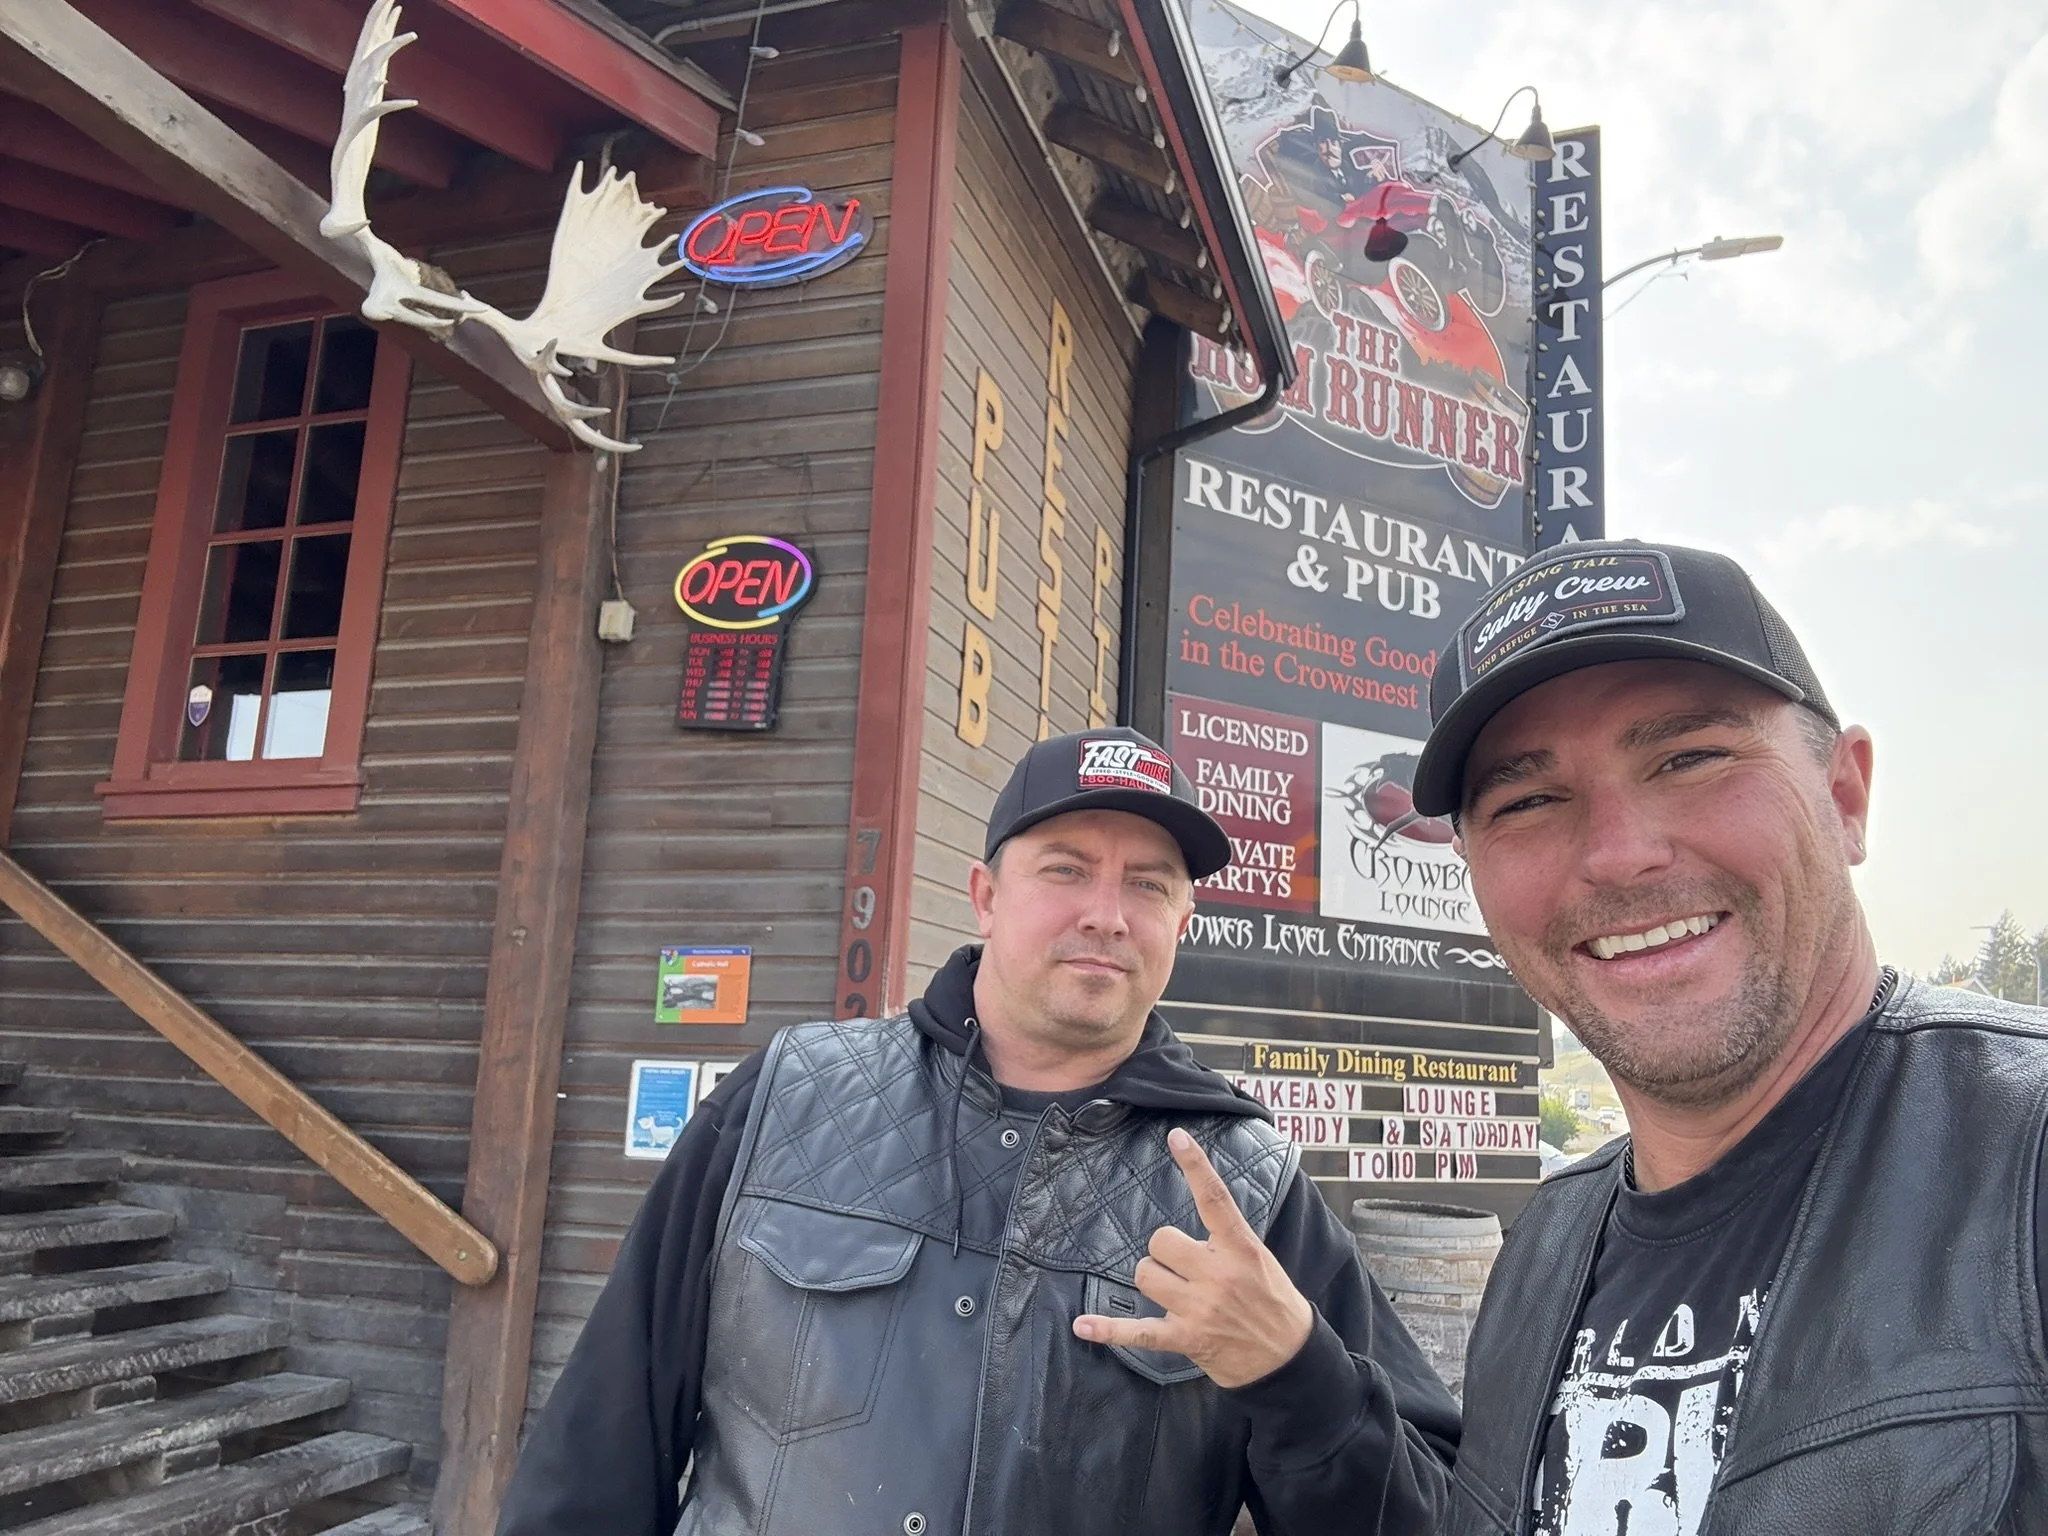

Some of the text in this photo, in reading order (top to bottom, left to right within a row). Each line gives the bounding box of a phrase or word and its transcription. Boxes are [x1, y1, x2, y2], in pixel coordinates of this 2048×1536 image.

[687, 199, 860, 265] OPEN
[1333, 312, 1399, 373] THE
[1326, 354, 1523, 482] RUNNER
[1184, 458, 1526, 588] RESTAURANT
[957, 367, 1005, 749] PUB
[682, 560, 799, 605] OPEN
[1287, 544, 1441, 620] & PUB
[1485, 556, 1619, 617] CHASING TAIL
[1187, 594, 1438, 678] Celebrating Good
[1473, 574, 1650, 655] Salty Crew
[1476, 602, 1648, 676] FIND REFUGE IN THE SEA
[1180, 630, 1209, 666] in
[1219, 649, 1265, 677] the
[1274, 653, 1419, 710] Crowsnest
[1180, 710, 1309, 757] LICENSED
[1078, 740, 1152, 775] FAST
[1136, 761, 1169, 784] HOUSE
[1196, 758, 1294, 798] FAMILY
[1197, 786, 1291, 825] DINING
[1227, 837, 1297, 872] VATE
[1193, 865, 1292, 898] ARTYS
[1379, 890, 1472, 925] LOUNGE
[1179, 913, 1254, 951] OWER
[1253, 1044, 1518, 1084] Family Dining Restaurant
[1405, 1086, 1490, 1117] LOUNGE
[1386, 1118, 1401, 1145] &
[1421, 1120, 1535, 1150] SATURDAY
